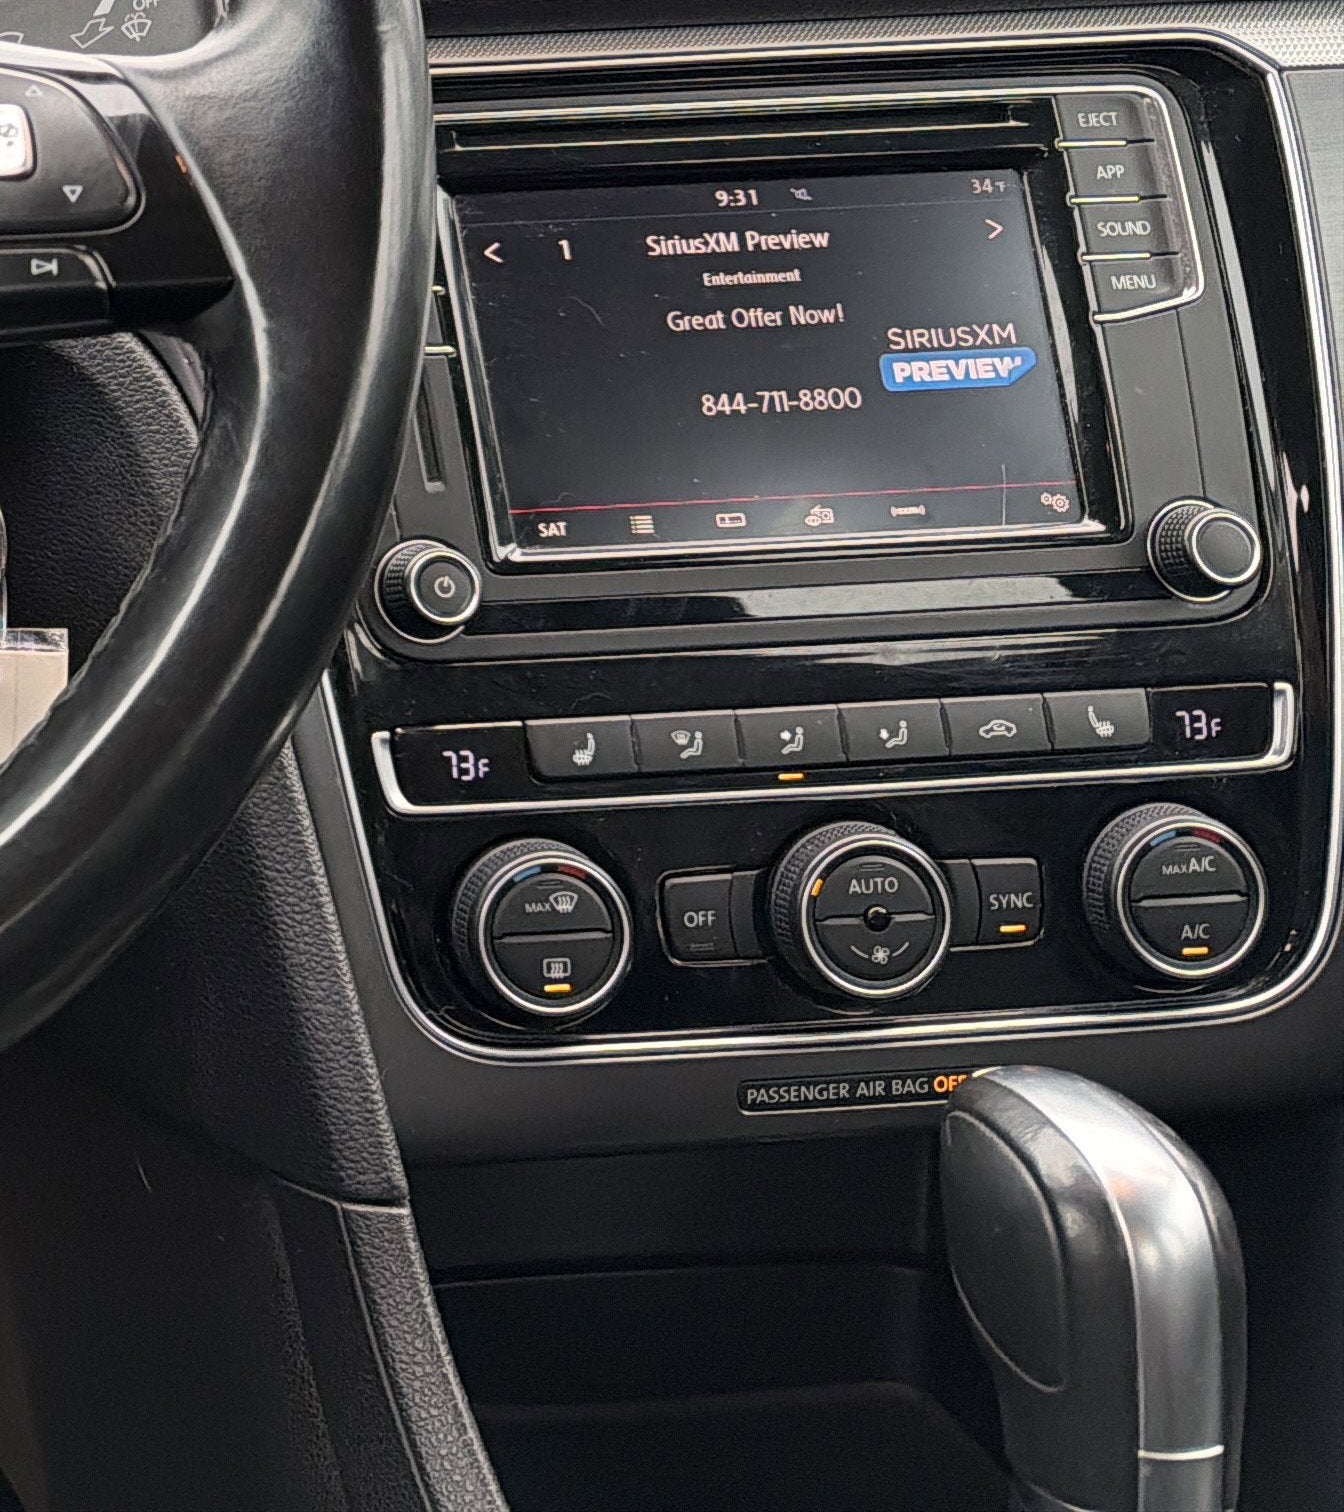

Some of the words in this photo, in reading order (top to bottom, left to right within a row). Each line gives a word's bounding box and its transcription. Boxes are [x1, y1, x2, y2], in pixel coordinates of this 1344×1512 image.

[1077, 111, 1119, 128] EJECT
[1096, 164, 1125, 180] APP
[714, 188, 759, 207] 9:31
[1096, 220, 1151, 237] SOUND
[558, 240, 572, 259] 1
[645, 232, 740, 257] SiriusXM
[746, 229, 831, 252] Preview
[702, 268, 802, 287] Entertainment
[1110, 274, 1157, 290] MENU
[666, 310, 727, 332] Great
[730, 306, 783, 329] Offer
[789, 302, 846, 325] Now!
[887, 323, 1017, 350] SIRIUSXM
[892, 356, 1023, 384] PREVIEW
[701, 387, 863, 416] 844-711-8800
[538, 521, 567, 538] SAT
[1188, 855, 1217, 874] A/C
[848, 877, 899, 896] AUTO
[524, 902, 551, 914] MAX
[989, 892, 1034, 911] SYNC
[683, 910, 717, 928] OFF
[1181, 922, 1210, 941] A/C
[746, 1083, 851, 1105] PASSENGER
[856, 1081, 886, 1098] AIR
[891, 1077, 929, 1096] BAG
